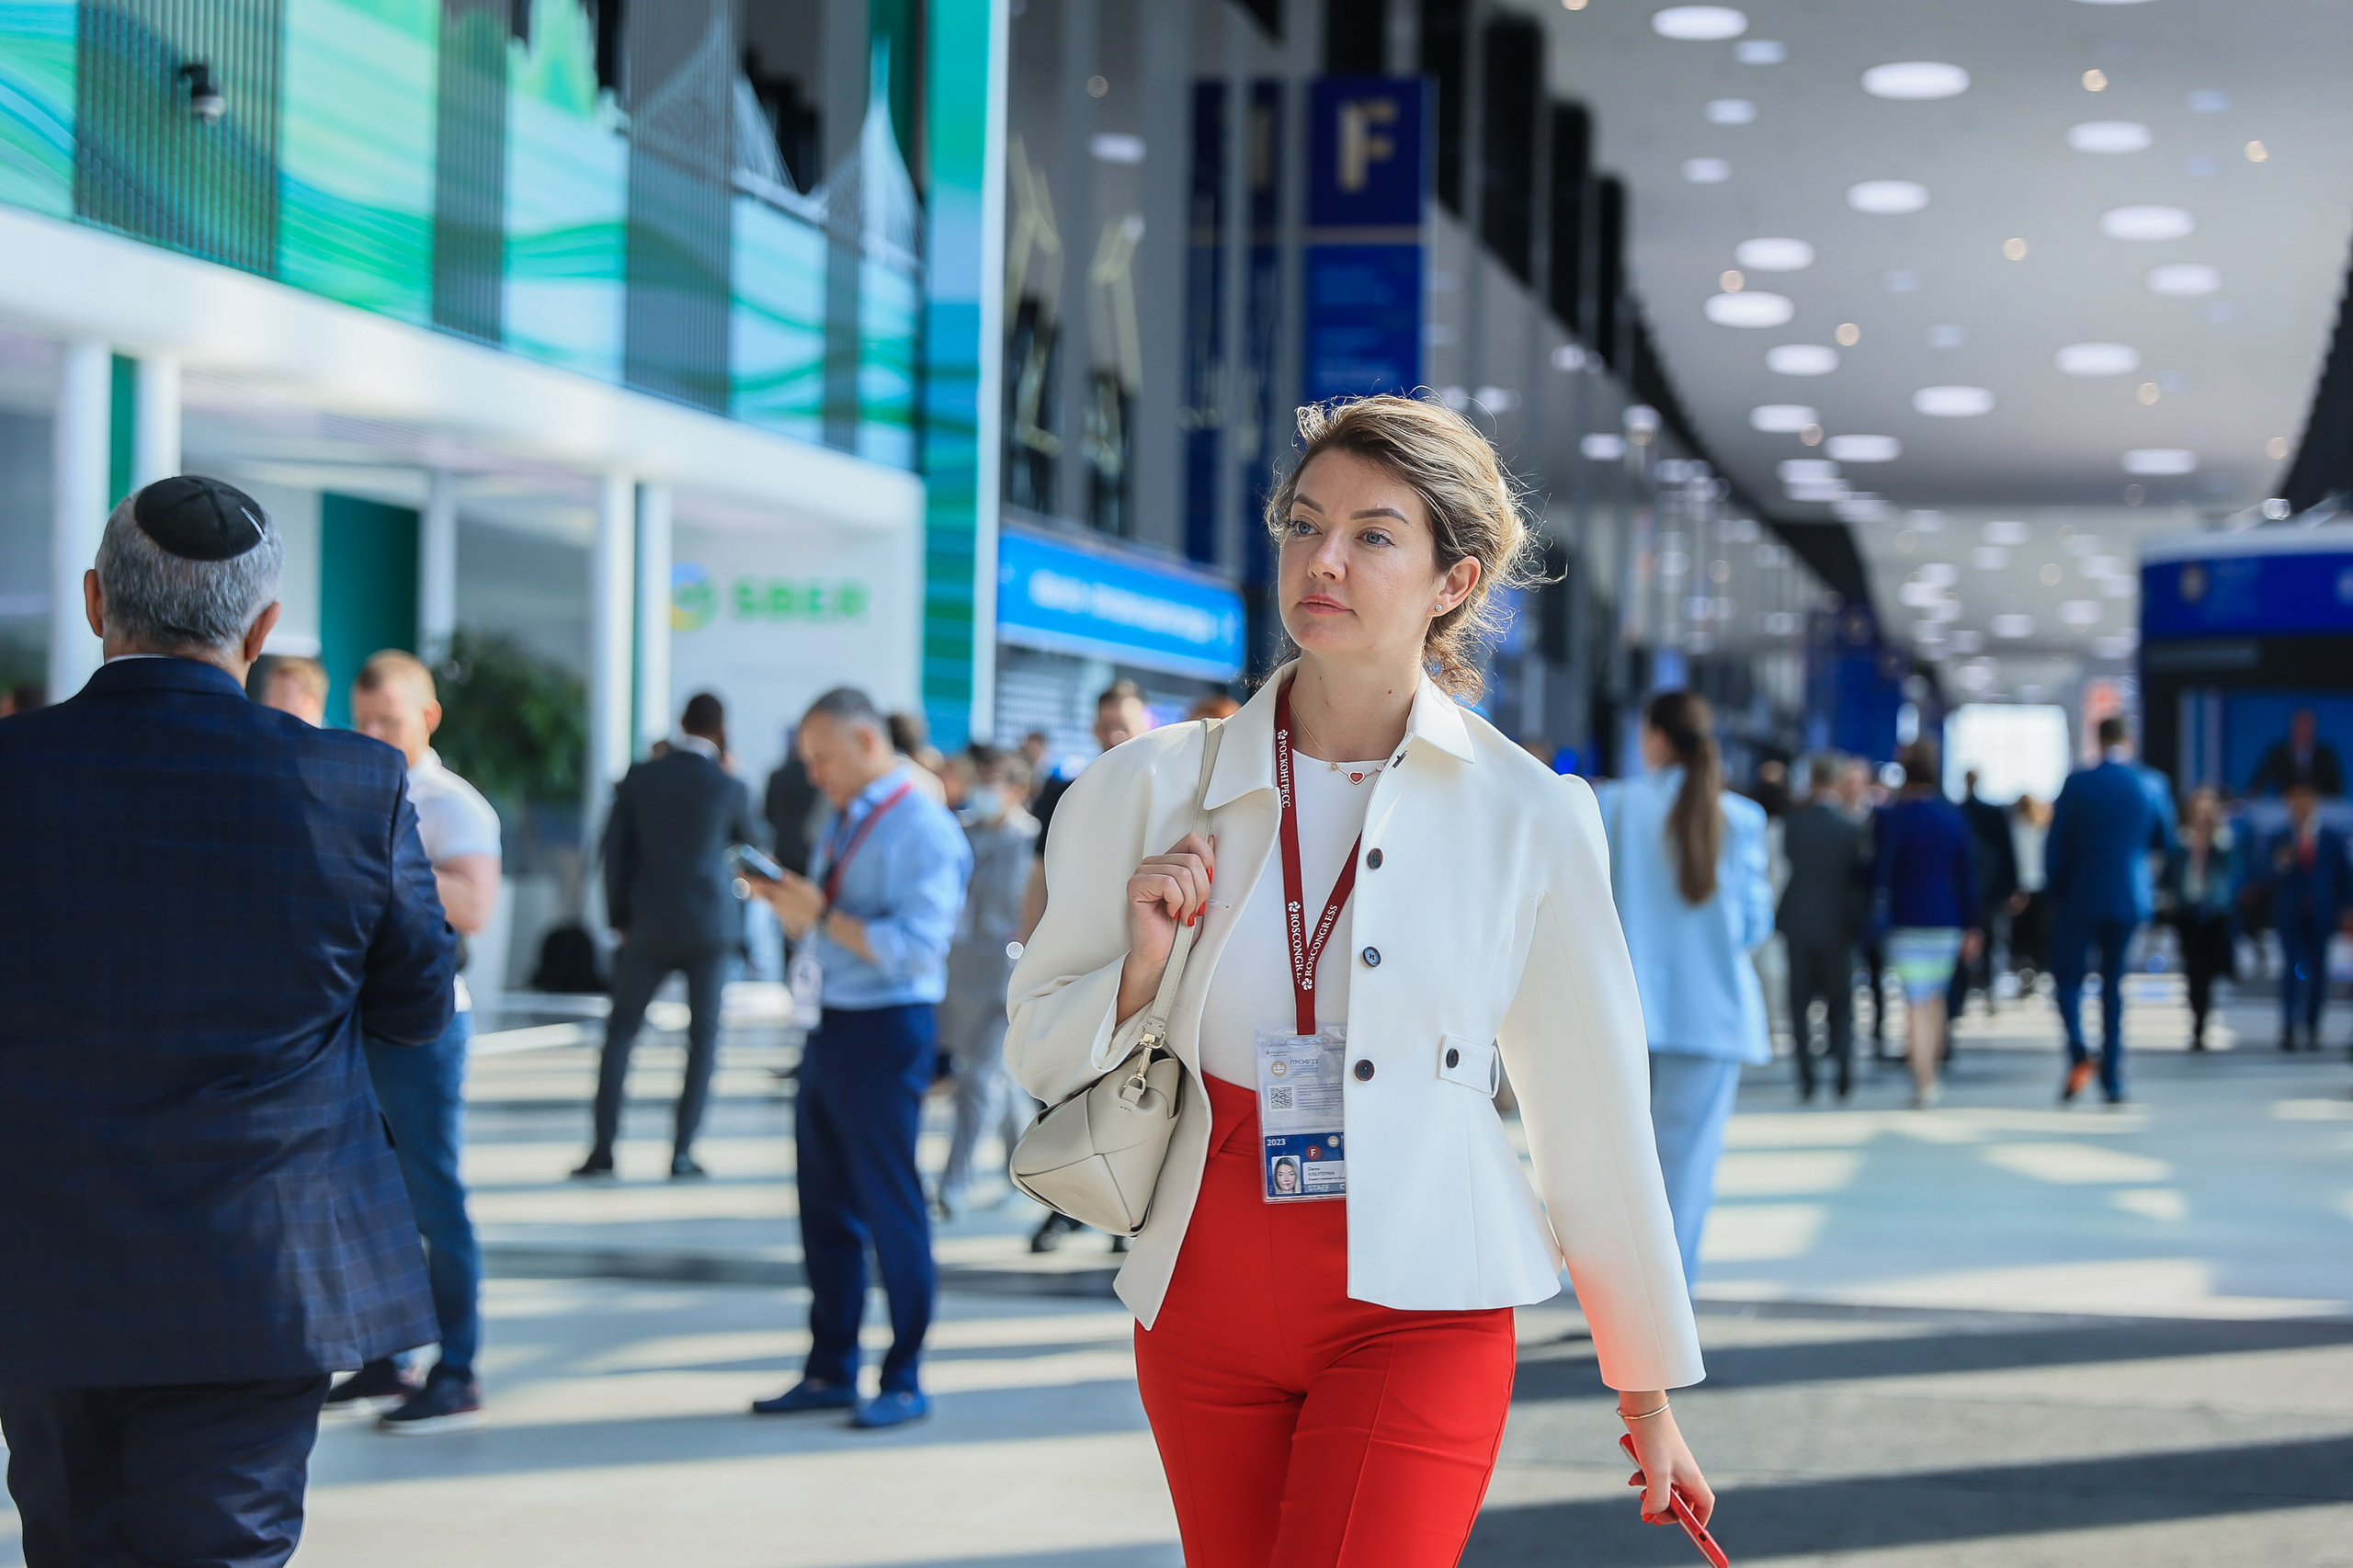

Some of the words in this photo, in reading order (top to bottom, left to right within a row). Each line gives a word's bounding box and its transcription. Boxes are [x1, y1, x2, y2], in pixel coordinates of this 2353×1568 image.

[1337, 98, 1399, 191] F
[1279, 739, 1291, 809] РОСКОНГРЕСС
[1304, 904, 1338, 977] ROSCONGRESS
